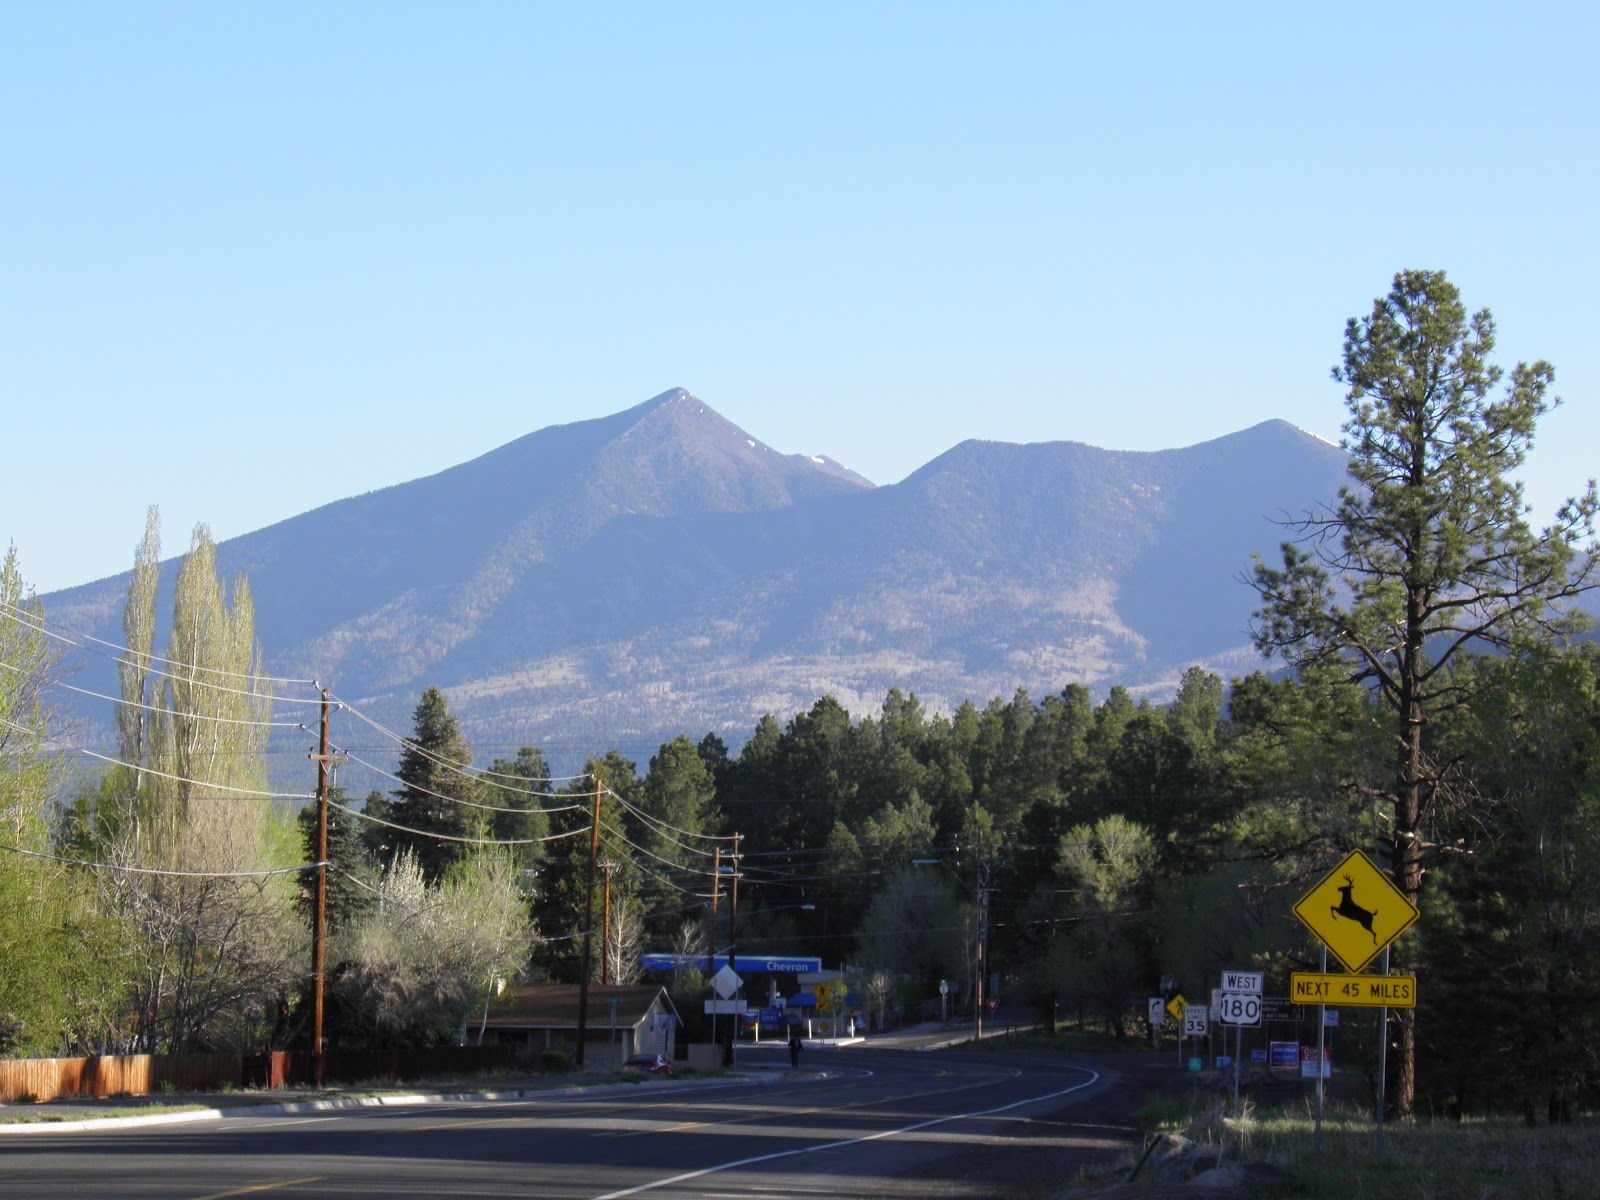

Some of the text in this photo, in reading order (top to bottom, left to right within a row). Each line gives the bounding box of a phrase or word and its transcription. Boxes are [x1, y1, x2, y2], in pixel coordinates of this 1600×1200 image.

[766, 961, 809, 972] Chevron
[1227, 974, 1258, 989] WEST
[1297, 981, 1410, 999] NEXT 45 MILES
[1223, 1000, 1258, 1018] 180
[1187, 1021, 1205, 1032] 35
